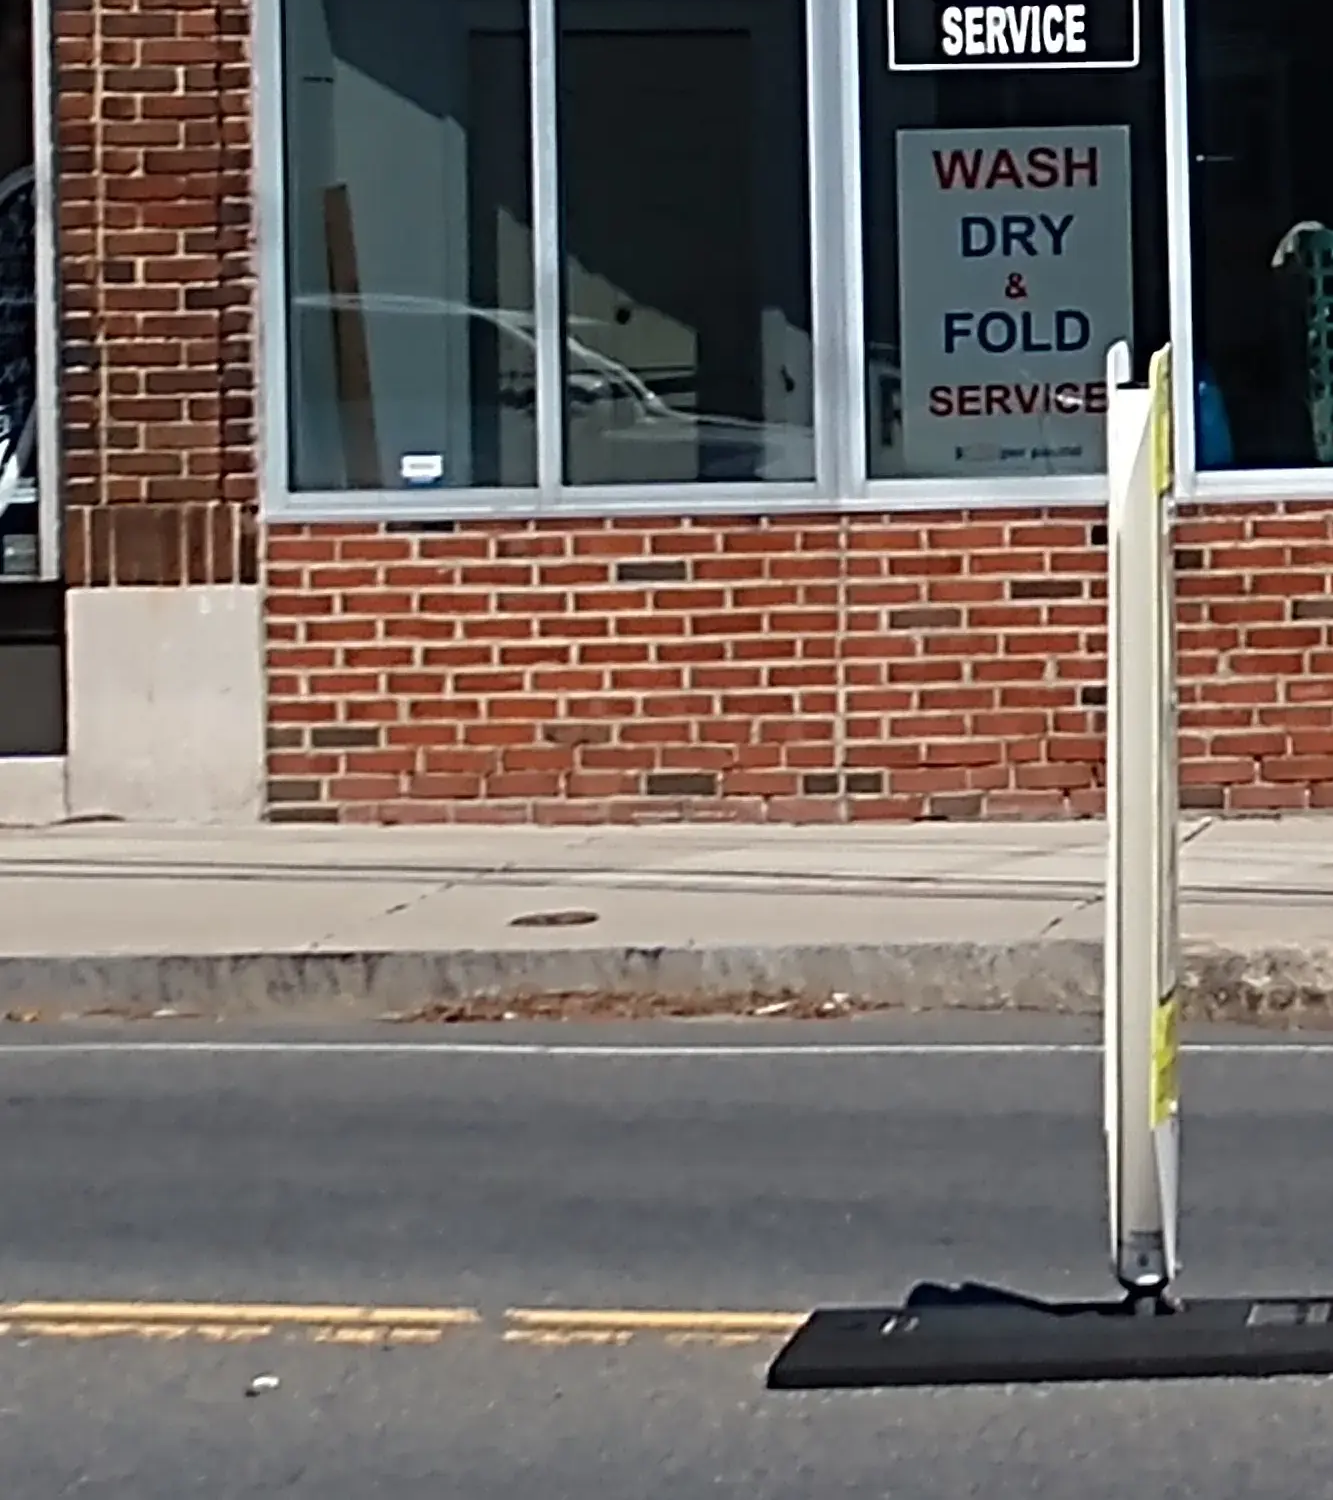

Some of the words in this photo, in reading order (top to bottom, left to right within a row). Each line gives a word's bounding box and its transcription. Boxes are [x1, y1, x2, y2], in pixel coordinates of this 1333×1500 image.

[941, 3, 1087, 56] SERVICE
[932, 146, 1099, 190] WASH
[960, 213, 1074, 258] DRY
[1004, 272, 1028, 300] &
[944, 309, 1091, 354] FOLD
[928, 382, 1109, 417] SERVICE
